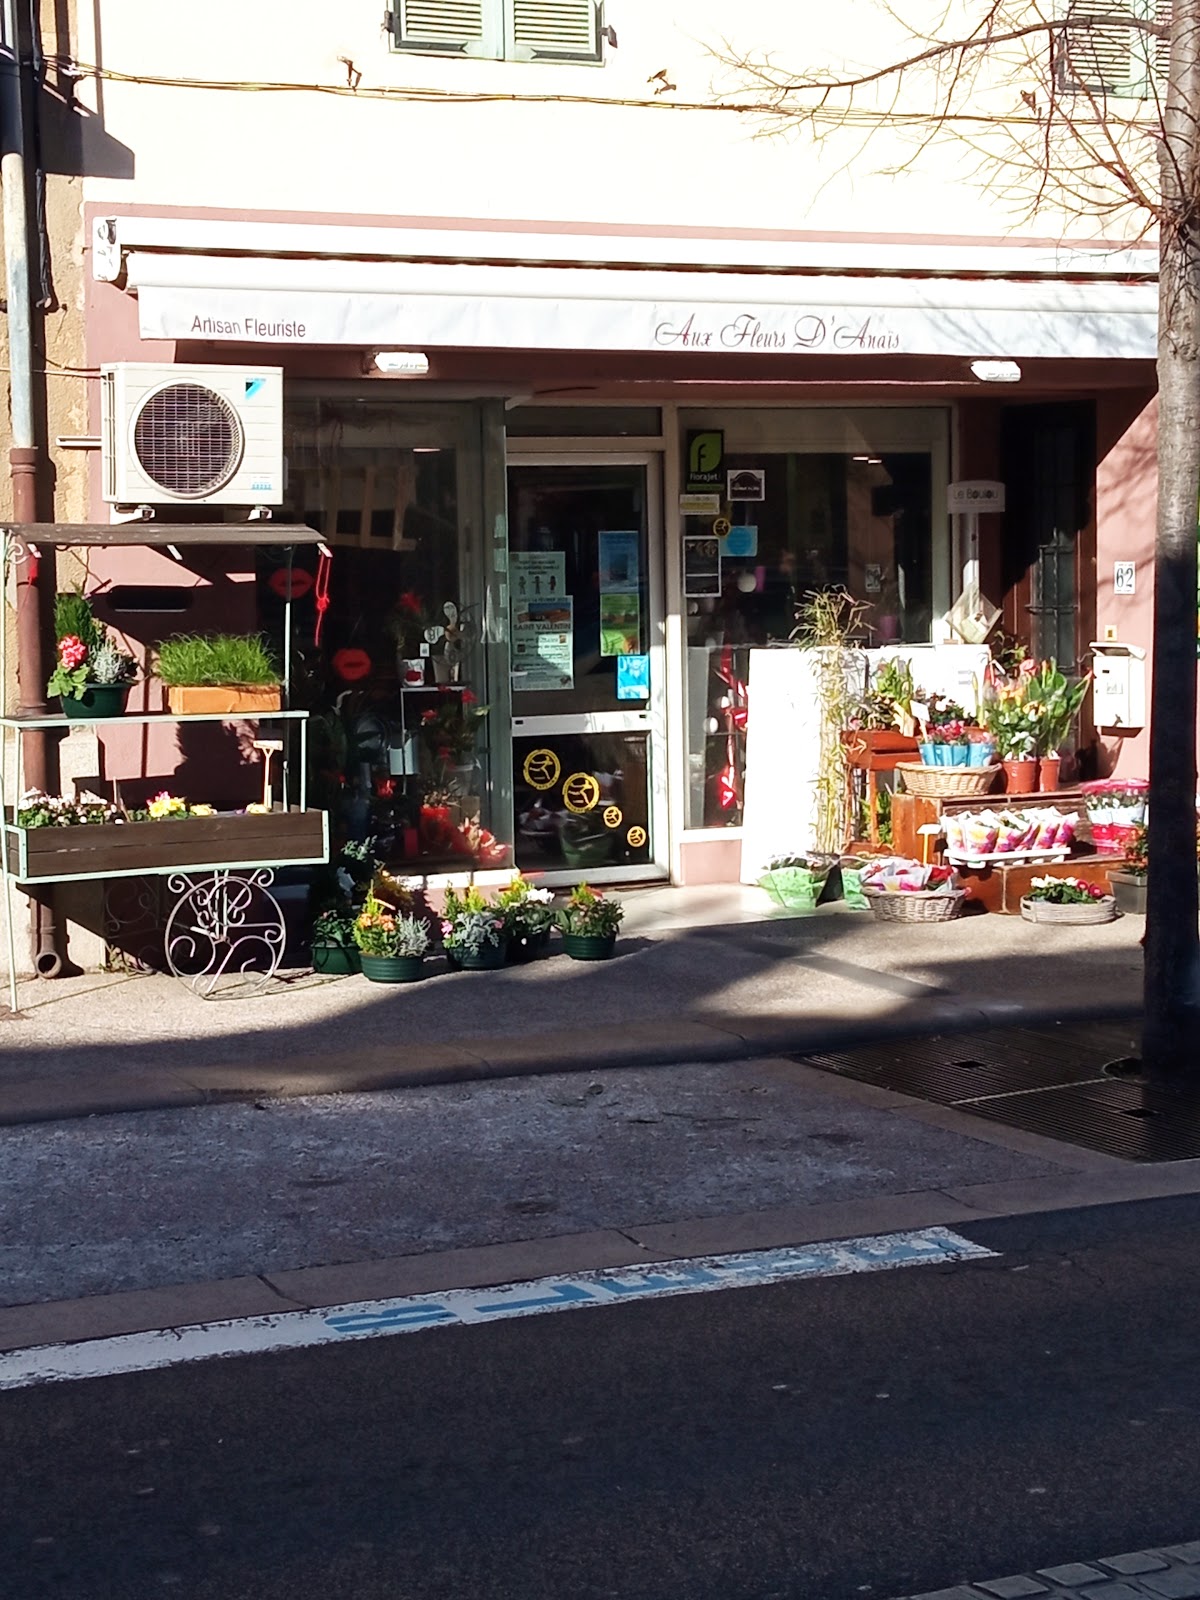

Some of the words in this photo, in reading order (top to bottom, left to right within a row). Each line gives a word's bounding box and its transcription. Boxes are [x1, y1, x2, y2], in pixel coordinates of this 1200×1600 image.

[191, 315, 241, 335] Artisan
[245, 318, 306, 338] Fleuriste
[654, 312, 713, 347] Aux
[720, 314, 786, 348] Fleurs
[1116, 567, 1134, 588] 62
[536, 622, 571, 631] VALENTIN
